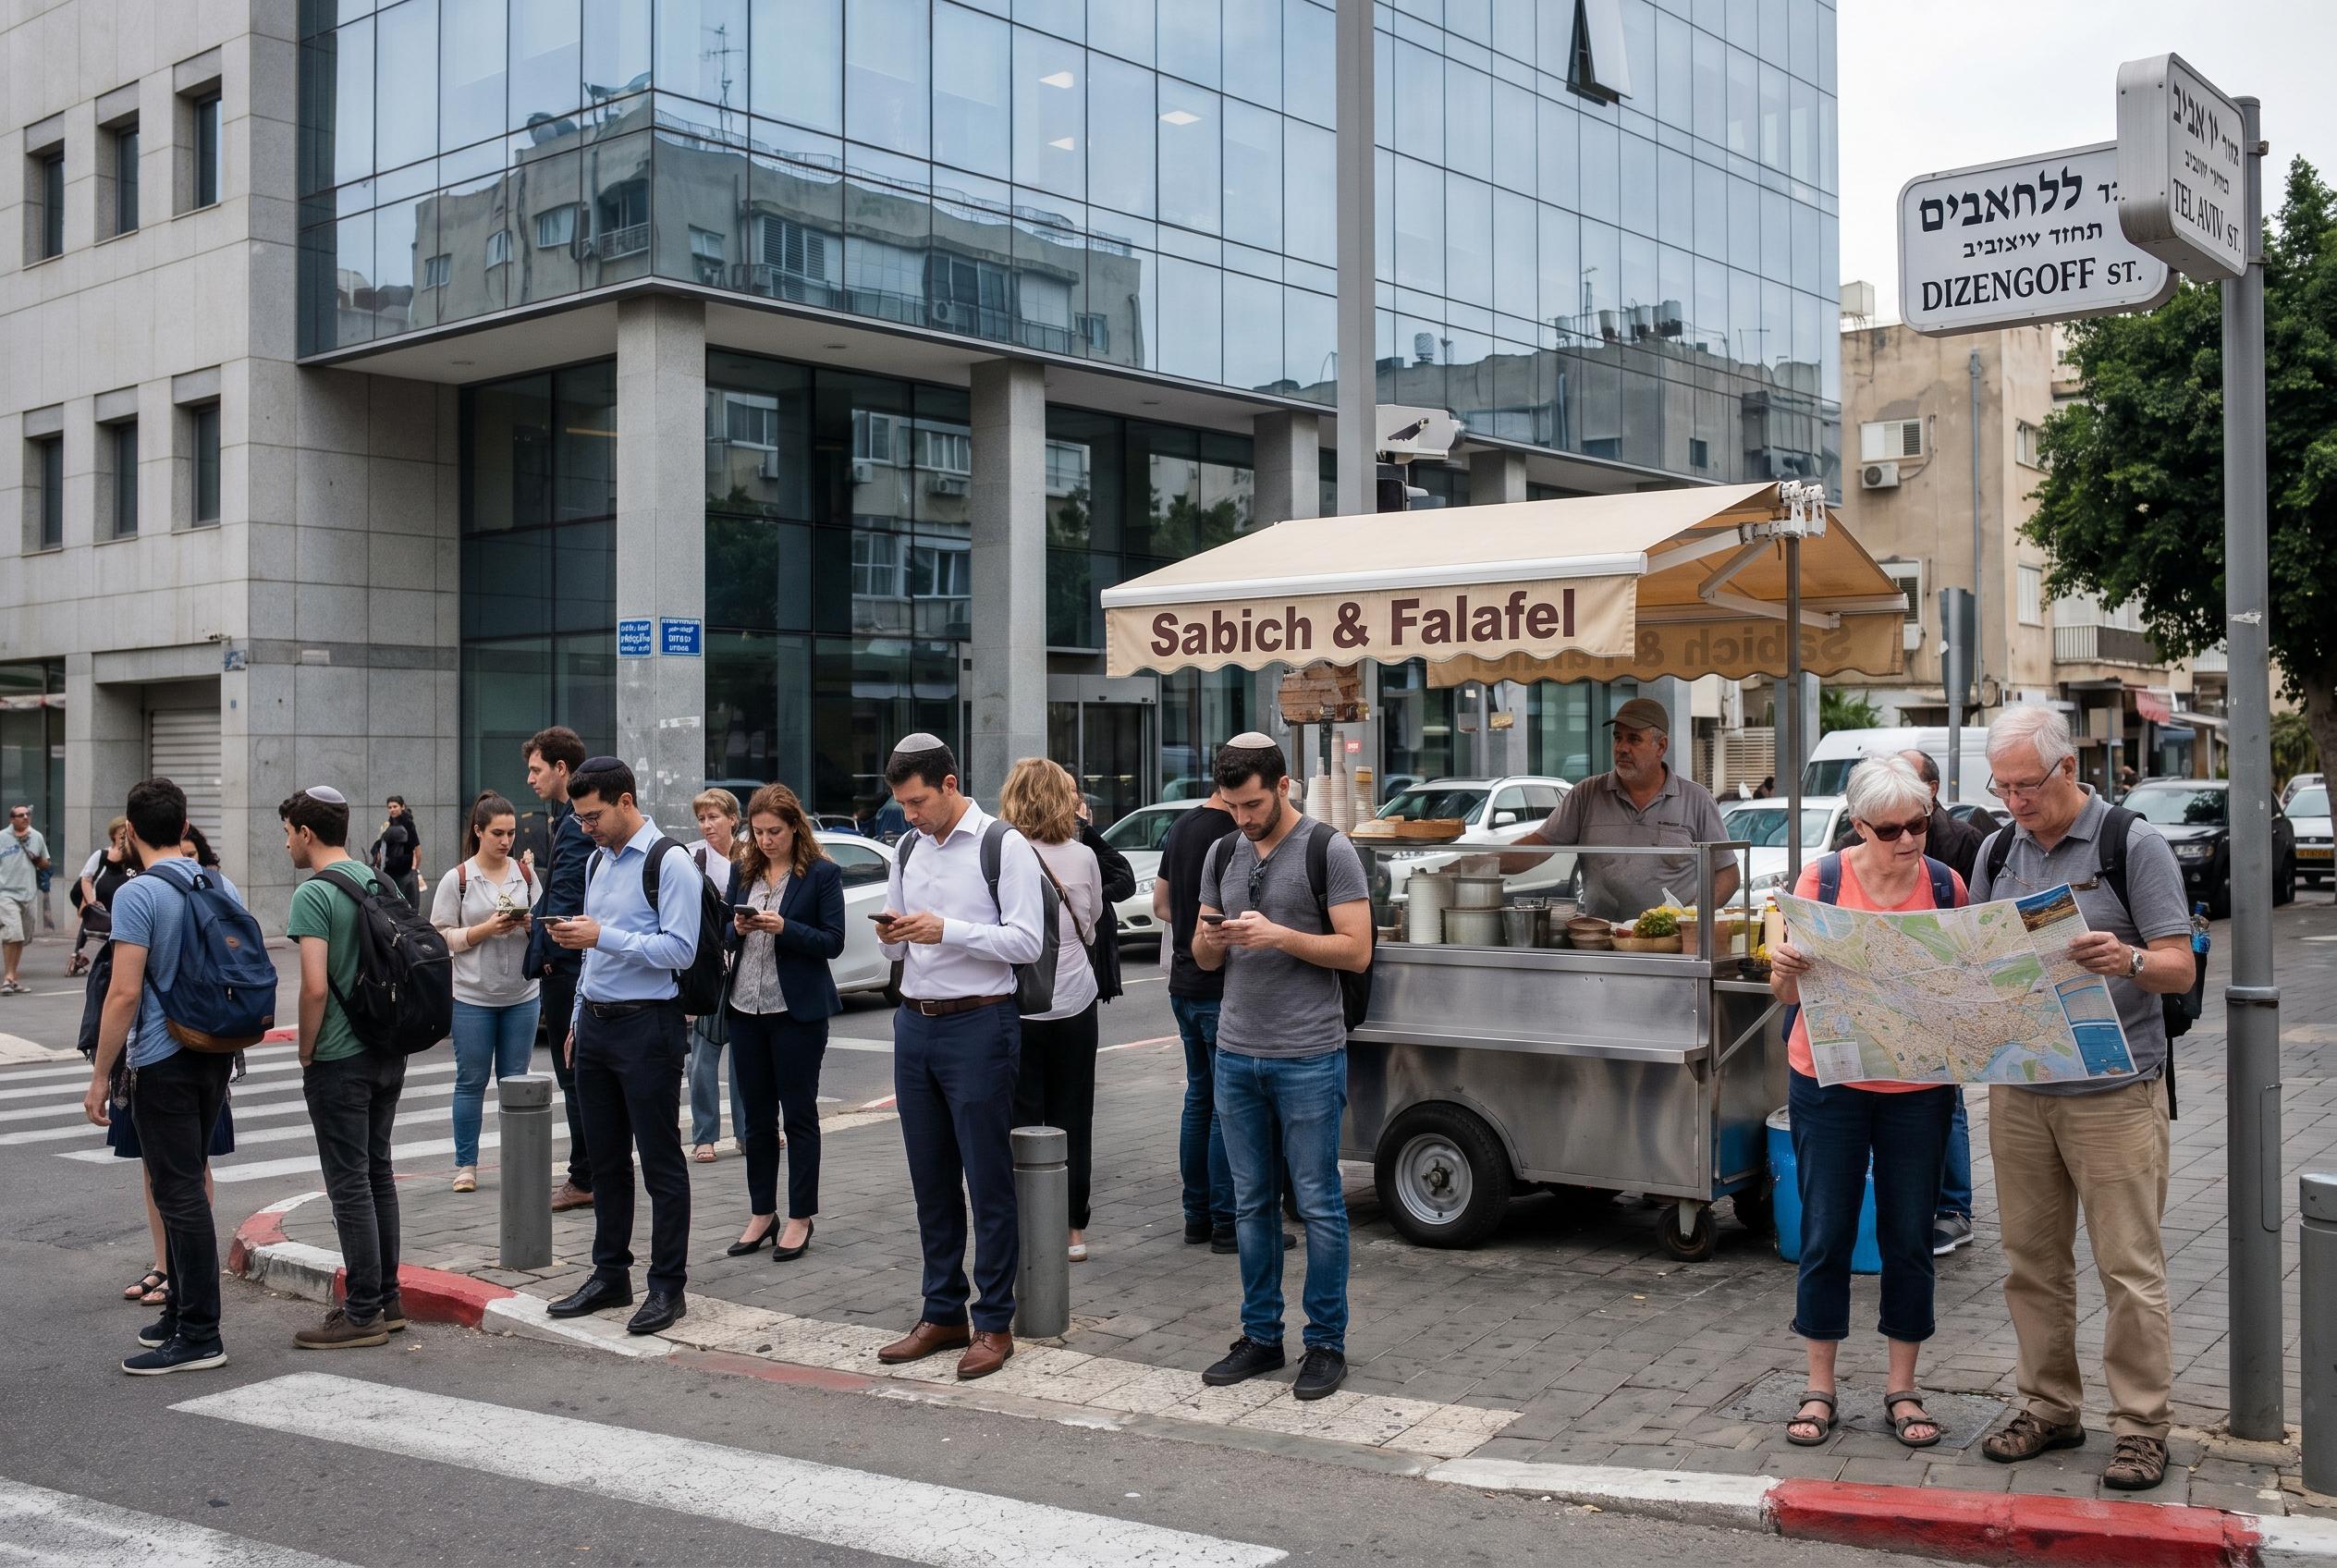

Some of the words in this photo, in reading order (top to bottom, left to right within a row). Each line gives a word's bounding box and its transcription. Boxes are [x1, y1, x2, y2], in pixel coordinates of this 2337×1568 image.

[2173, 178, 2195, 224] TEL
[2197, 196, 2223, 240] AVIV
[2228, 224, 2241, 253] ST.
[1922, 257, 2096, 311] DIZENGOFF
[2108, 261, 2142, 285] ST.
[1151, 606, 1312, 656] Sabich
[1333, 602, 1370, 648] &
[1391, 589, 1575, 645] Falafel
